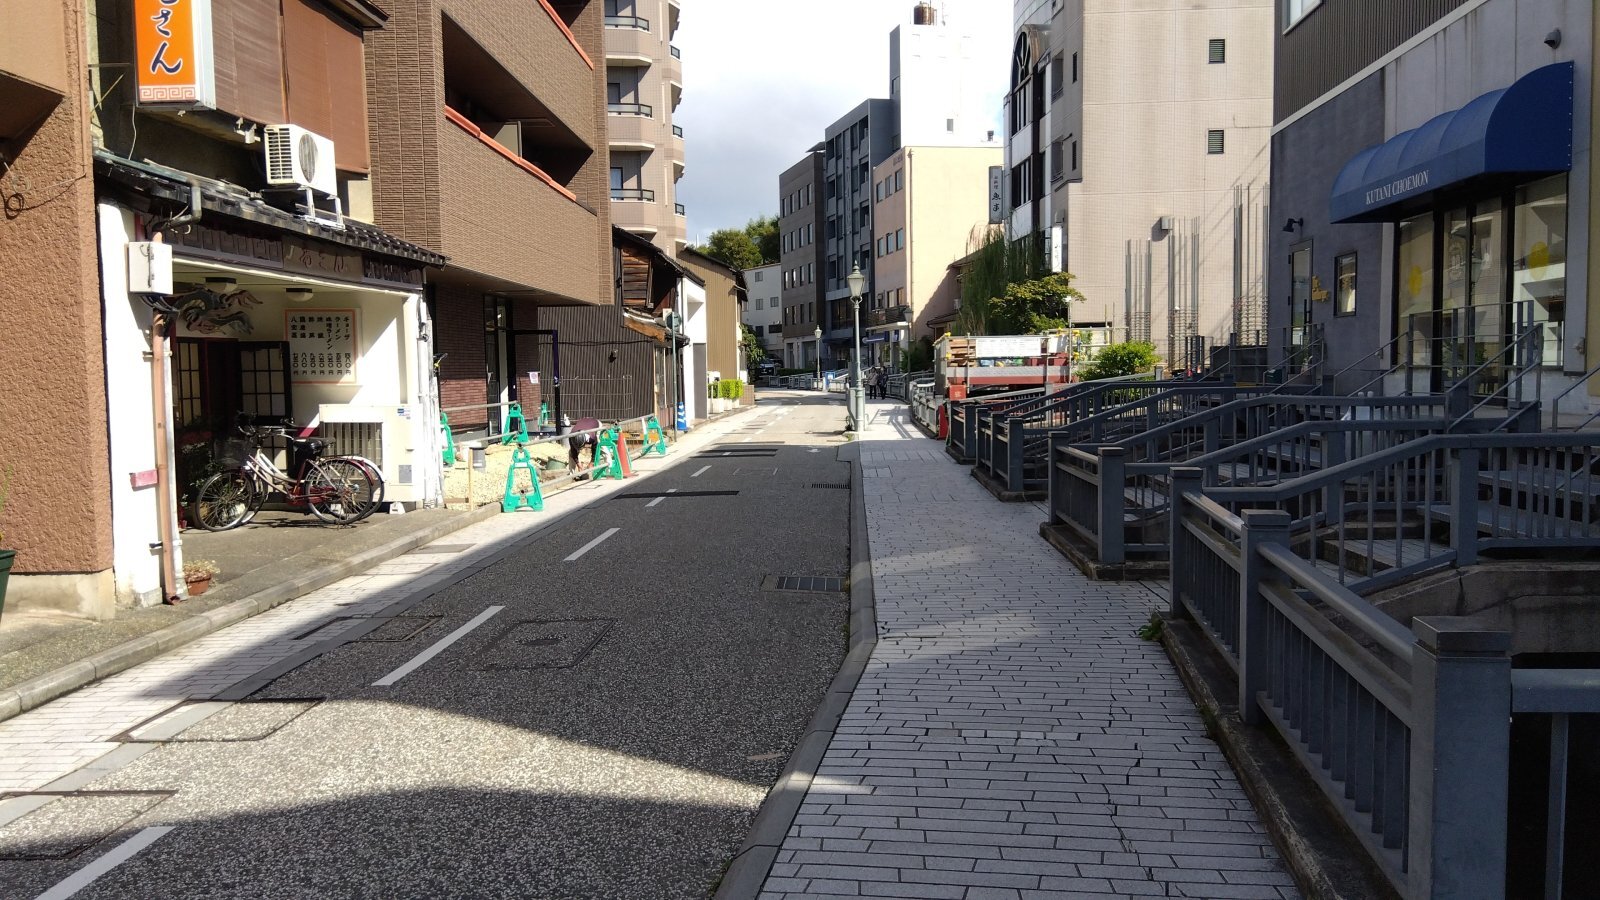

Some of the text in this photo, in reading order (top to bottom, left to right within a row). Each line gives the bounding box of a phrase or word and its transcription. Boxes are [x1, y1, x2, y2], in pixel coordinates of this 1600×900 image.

[150, 0, 182, 74] さん
[1366, 170, 1429, 205] KUTANI CHOEMON
